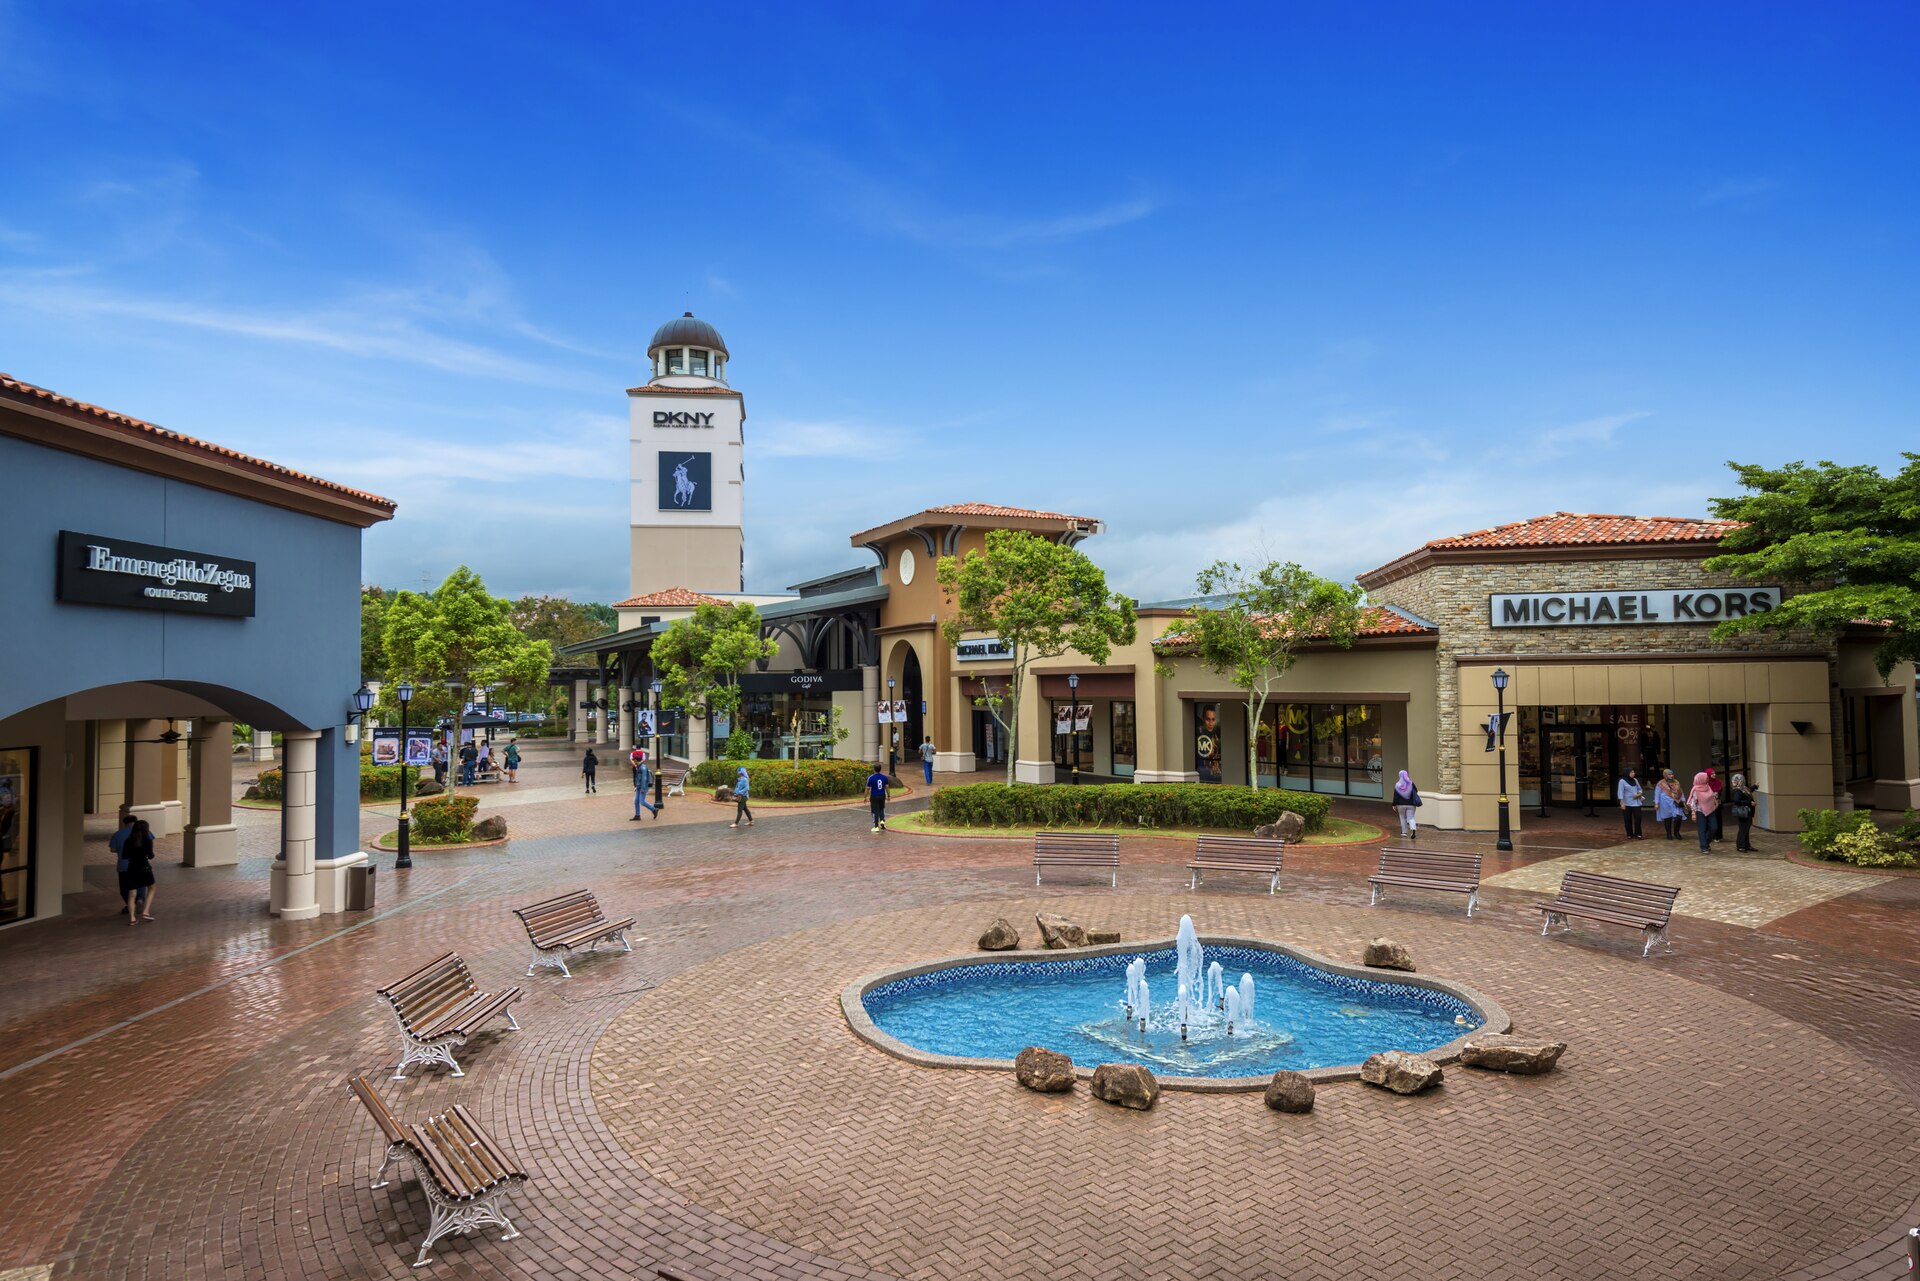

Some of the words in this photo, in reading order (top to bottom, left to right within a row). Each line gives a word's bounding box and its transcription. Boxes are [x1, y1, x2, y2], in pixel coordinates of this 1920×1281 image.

[653, 411, 715, 425] DKNY
[86, 544, 204, 586] Ermenegildo
[203, 563, 251, 593] Zegna
[182, 591, 208, 603] STORE
[1503, 595, 1659, 622] MICHAEL
[1674, 592, 1772, 619] KORS
[790, 675, 823, 683] GODIVA
[876, 779, 883, 790] 8
